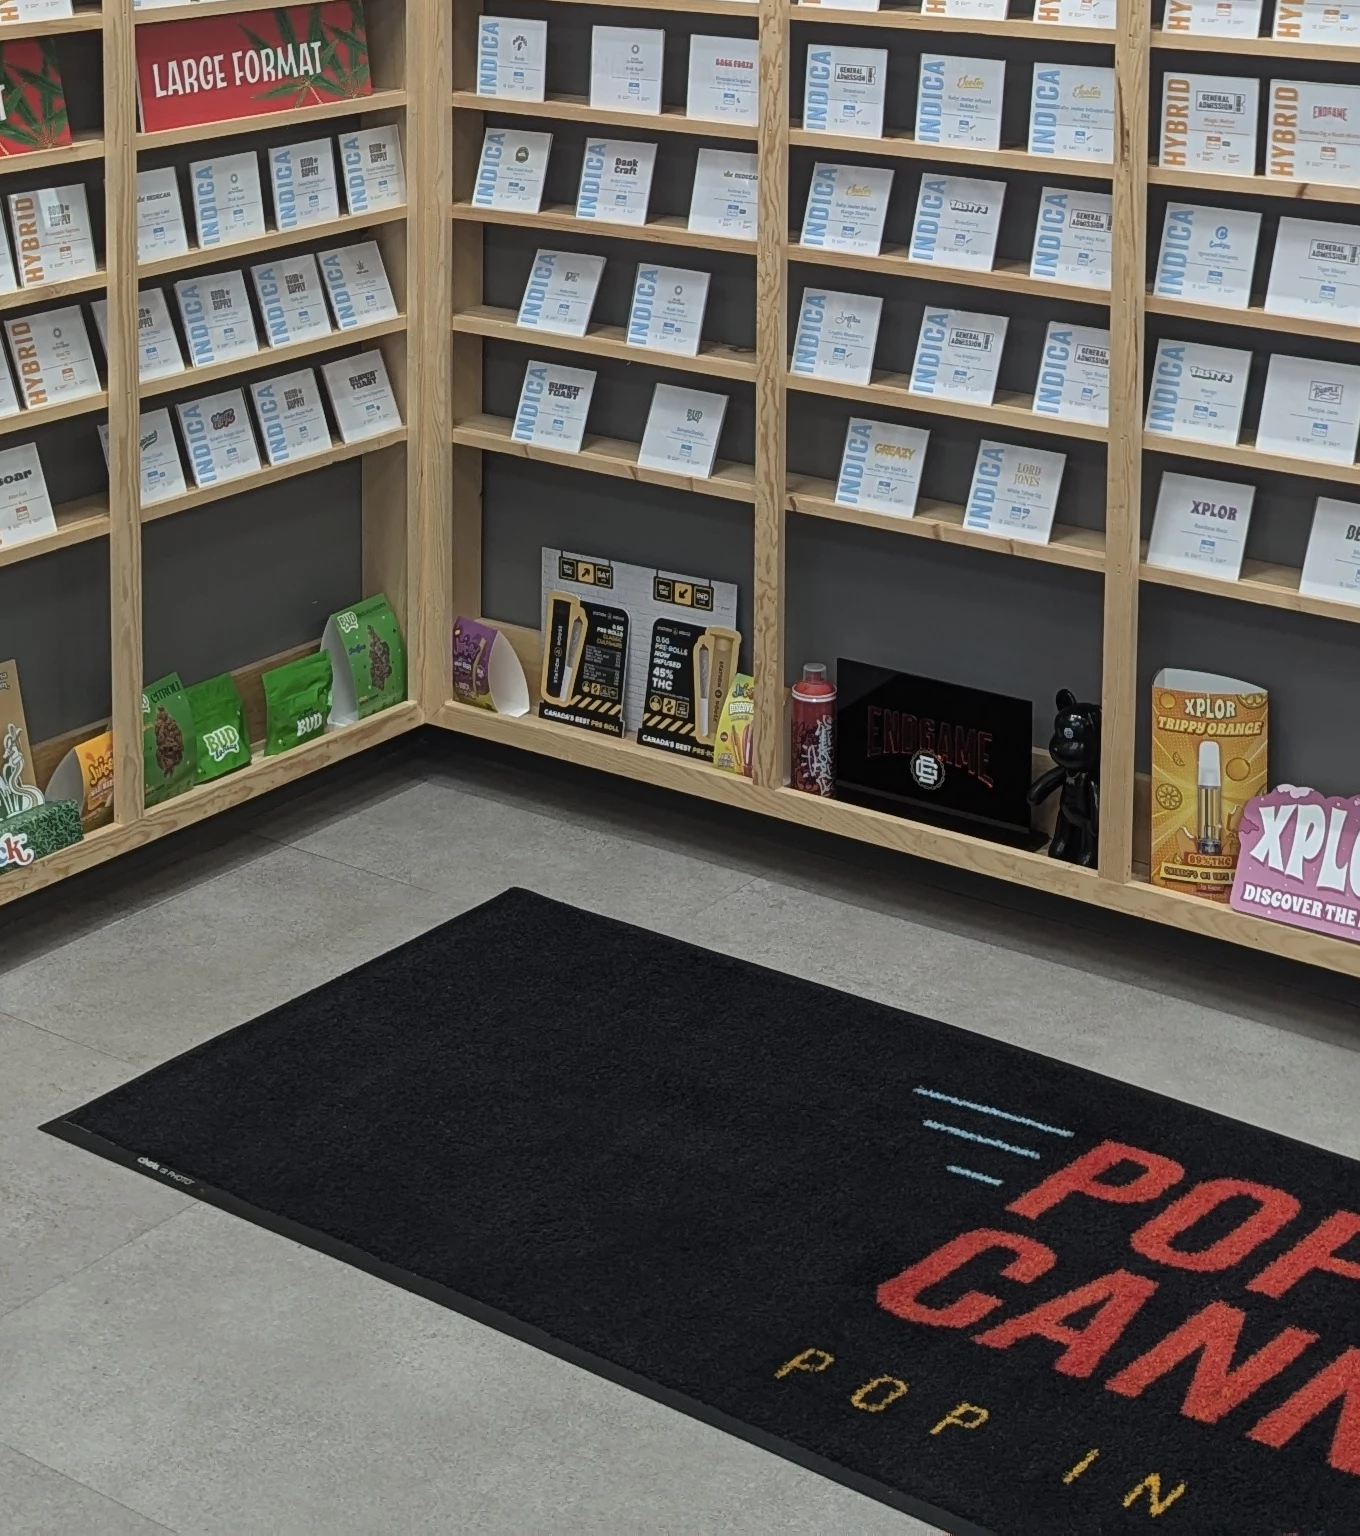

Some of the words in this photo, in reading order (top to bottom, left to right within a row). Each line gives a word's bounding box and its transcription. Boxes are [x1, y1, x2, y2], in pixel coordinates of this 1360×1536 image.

[151, 54, 227, 98] LARGE
[232, 41, 323, 84] FORMAT
[196, 165, 221, 245] INDICA
[1190, 500, 1238, 522] XPLOR
[652, 667, 674, 681] 45%
[652, 677, 674, 691] THC
[543, 708, 575, 723] CANADA'S
[575, 716, 590, 725] BEST
[1184, 697, 1237, 721] XPLOR
[297, 713, 323, 737] BUD
[1156, 716, 1208, 735] TRIPPY
[1207, 721, 1264, 737] ORANGE
[203, 726, 239, 754] BUD
[866, 705, 995, 789] ENDGAME
[1242, 882, 1323, 919] DISCOVER
[1324, 901, 1358, 926] THE
[772, 1345, 991, 1436] POP
[1060, 1446, 1187, 1520] IN
